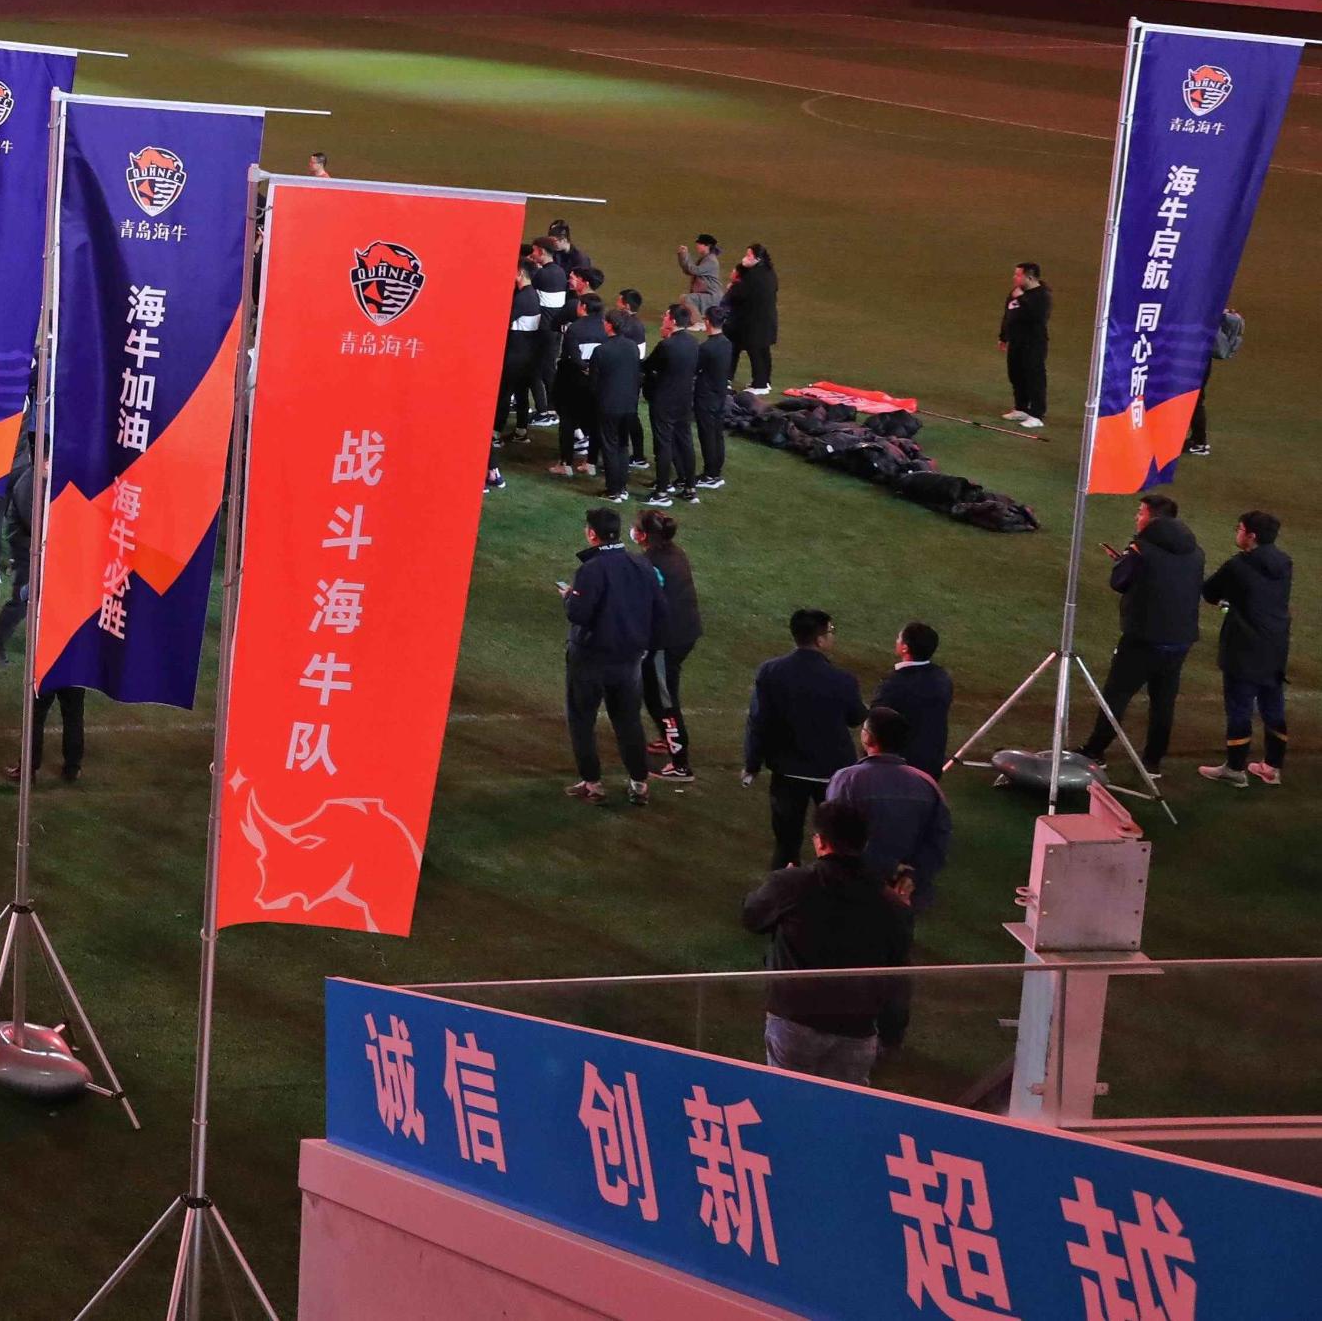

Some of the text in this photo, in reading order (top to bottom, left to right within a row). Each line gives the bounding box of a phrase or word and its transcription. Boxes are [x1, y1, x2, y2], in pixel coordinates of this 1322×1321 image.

[1170, 117, 1225, 135] 青岛海牛
[120, 219, 188, 243] 青岛海牛
[1130, 165, 1199, 430] 海牛启航 同心所向
[340, 331, 425, 358] 青岛海牛
[98, 285, 167, 640] 海牛加油 海牛必胜
[285, 429, 386, 776] 战斗海牛队
[662, 717, 683, 754] FILA
[364, 1012, 1198, 1321] 诚信 创新 超越
